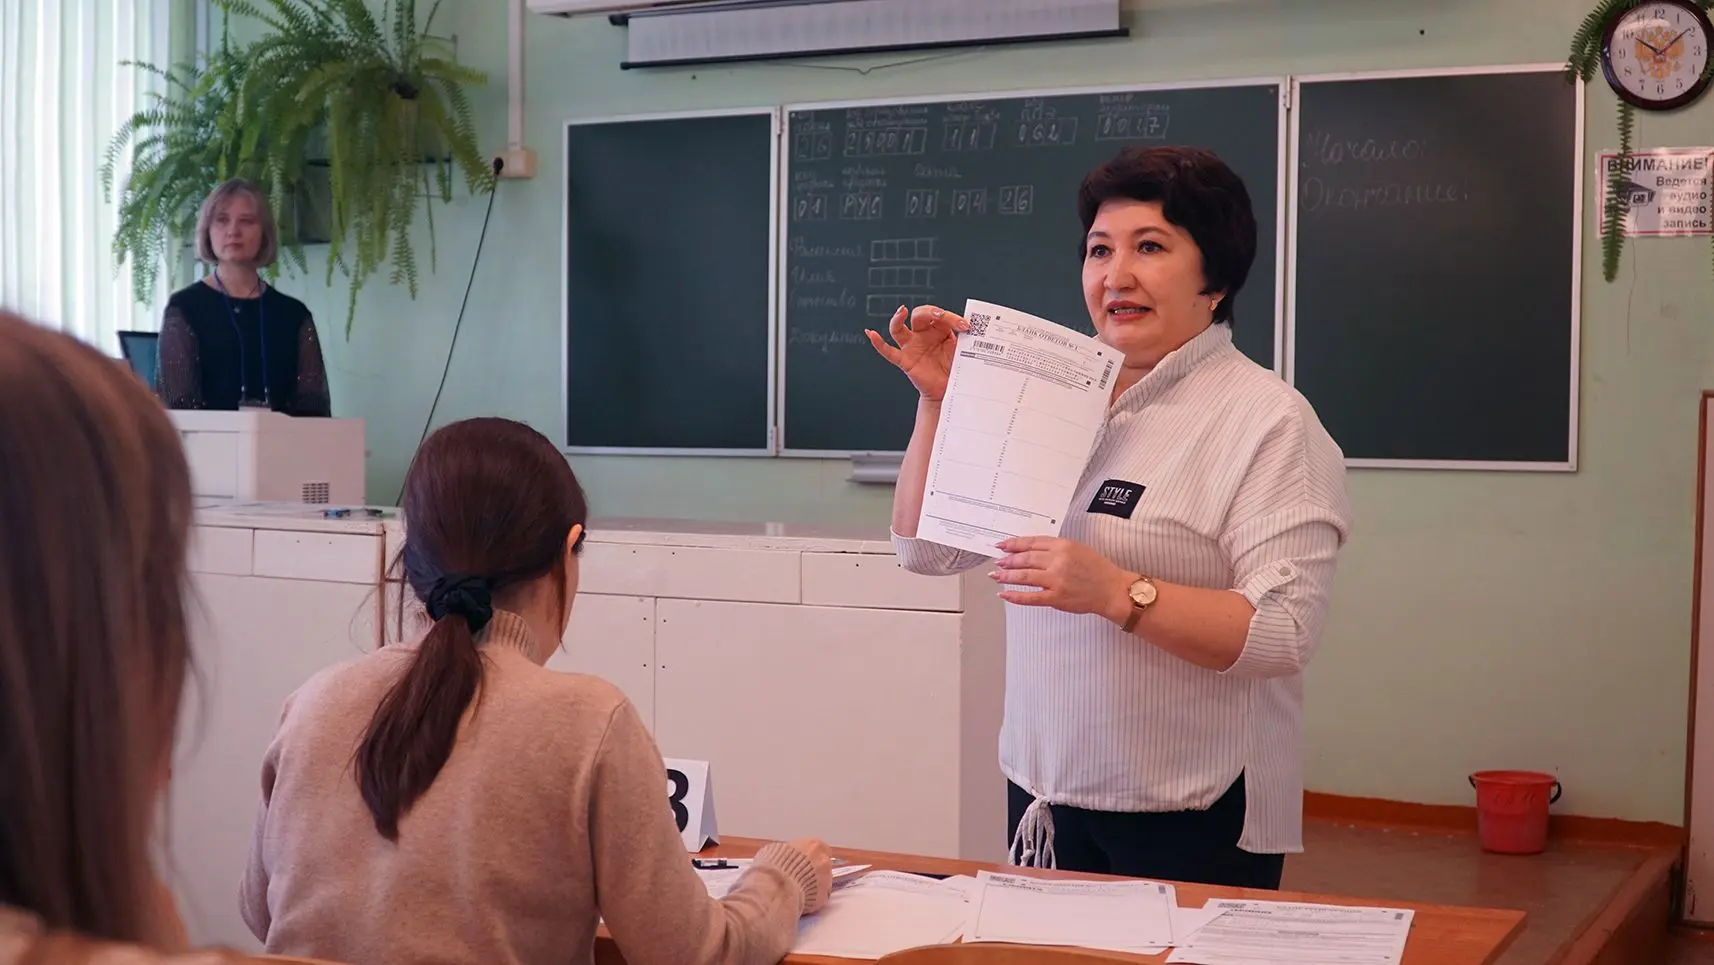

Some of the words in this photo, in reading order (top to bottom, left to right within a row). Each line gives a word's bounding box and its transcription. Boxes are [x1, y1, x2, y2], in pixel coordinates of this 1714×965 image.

[1655, 8, 1665, 20] 12
[1619, 48, 1626, 59] 9
[1693, 46, 1701, 56] 3
[1624, 66, 1632, 77] 8
[1639, 79, 1645, 91] 7
[1657, 81, 1664, 94] 6
[1676, 78, 1683, 89] 5
[1670, 191, 1707, 201] аудио
[843, 195, 880, 216] РУС
[1663, 219, 1707, 228] запись
[1100, 486, 1133, 502] STYLE
